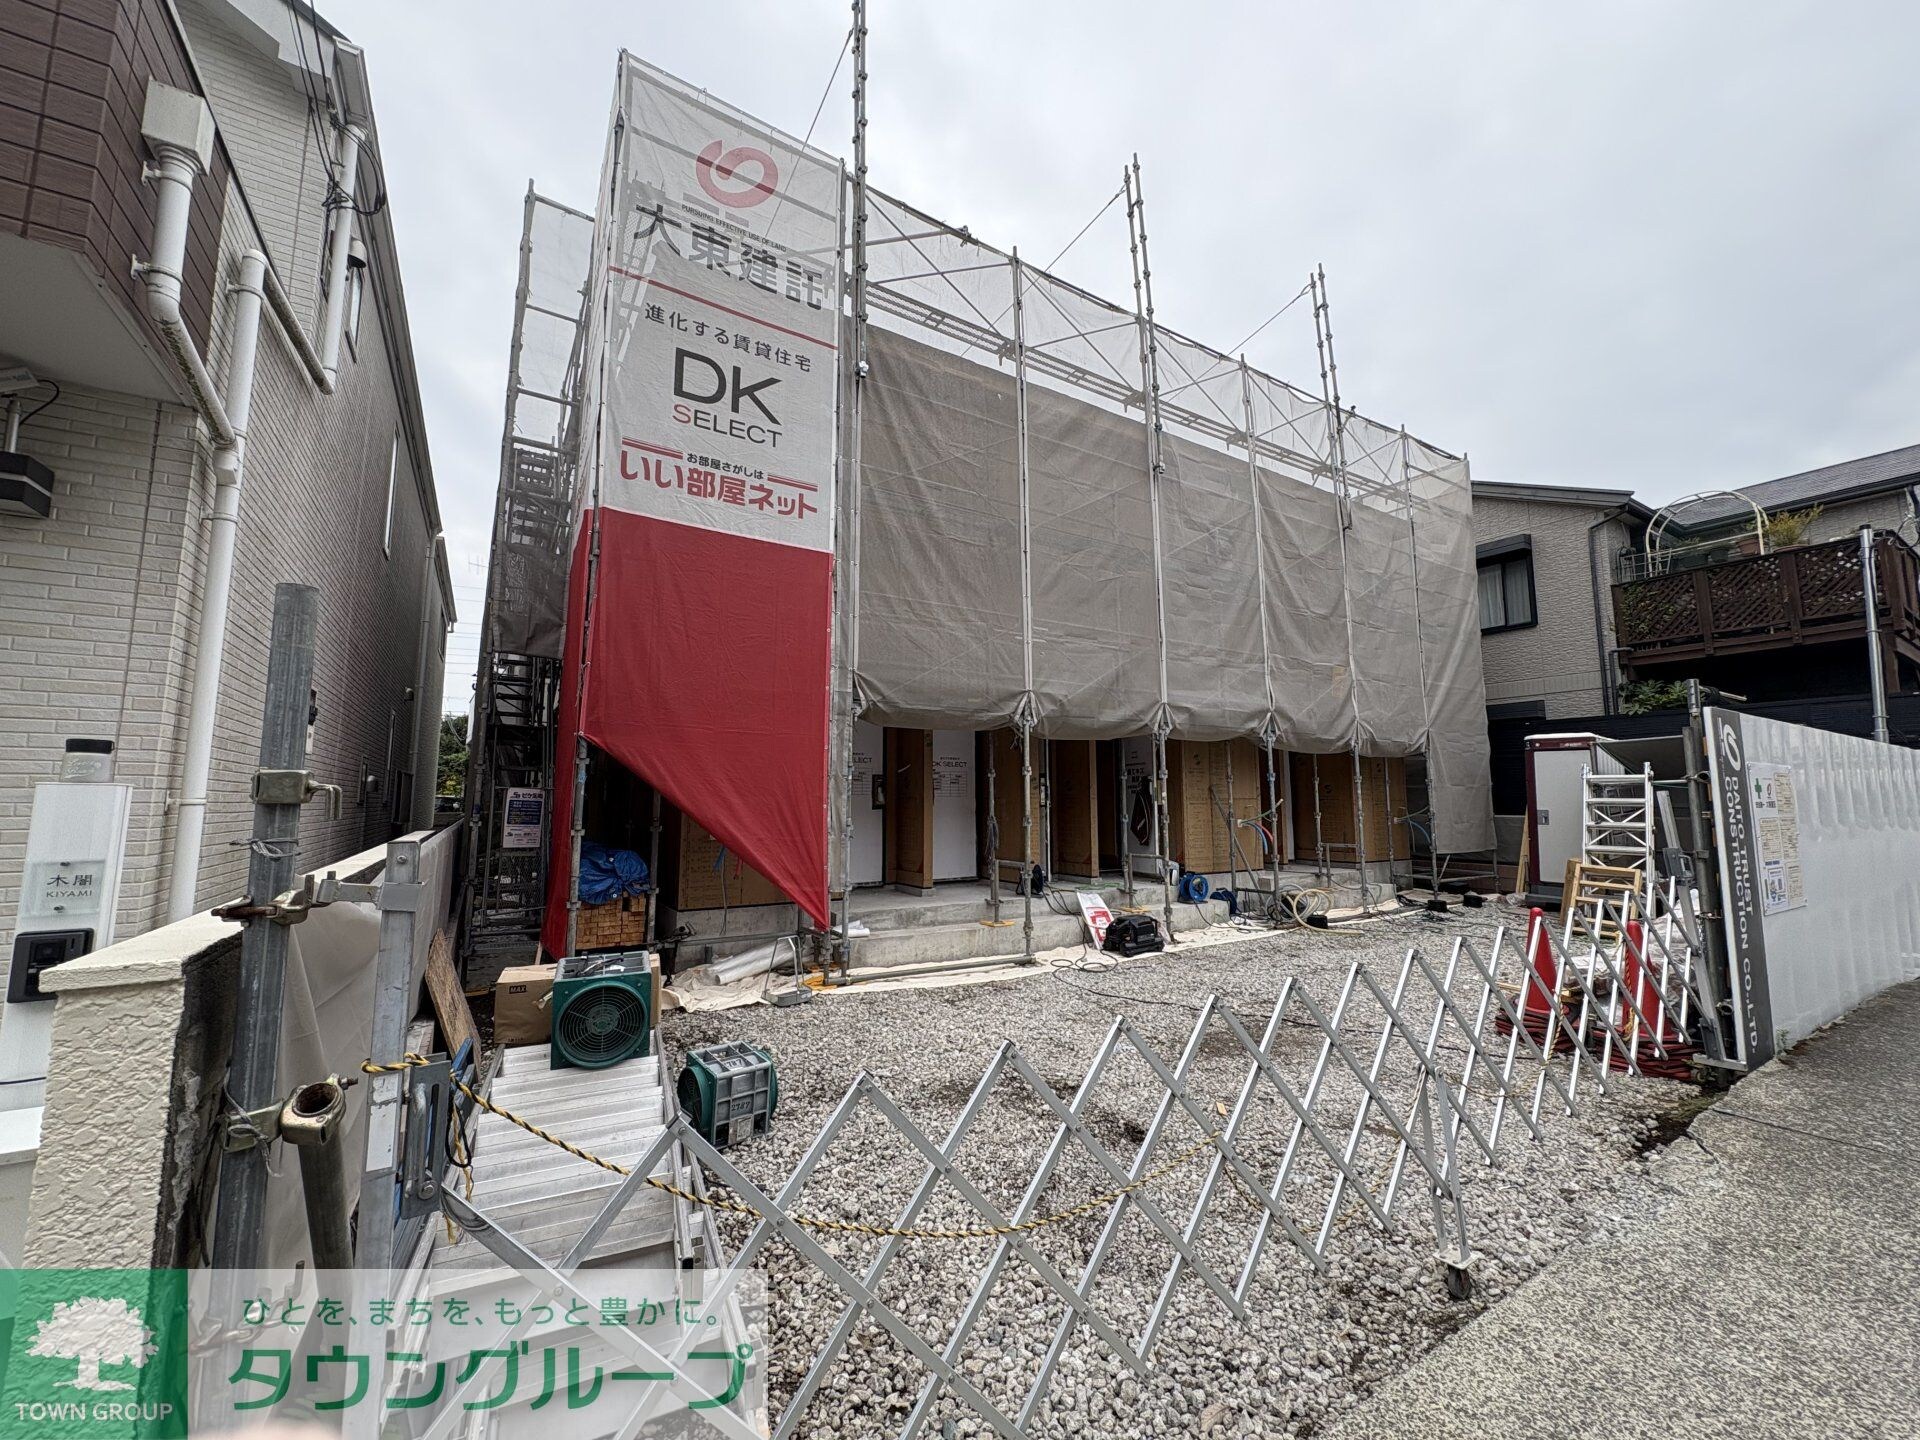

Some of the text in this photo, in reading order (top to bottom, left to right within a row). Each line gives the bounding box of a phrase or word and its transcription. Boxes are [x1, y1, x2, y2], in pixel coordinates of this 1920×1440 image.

[634, 204, 823, 310] 大東建託
[681, 204, 787, 253] PURSUING EFFECTIVE USE OF LAND
[645, 303, 811, 372] 進化する賃貸住宅
[673, 347, 782, 425] DK
[672, 404, 782, 447] SELECT
[620, 450, 818, 519] いい部屋ネット
[687, 453, 764, 480] お部屋さがしは
[1725, 776, 1749, 949] CONSTRUCTION
[1732, 777, 1754, 916] DAITO TRUST
[46, 890, 92, 898] KIYAMI
[510, 985, 526, 994] MAX
[731, 1101, 751, 1111] 2787
